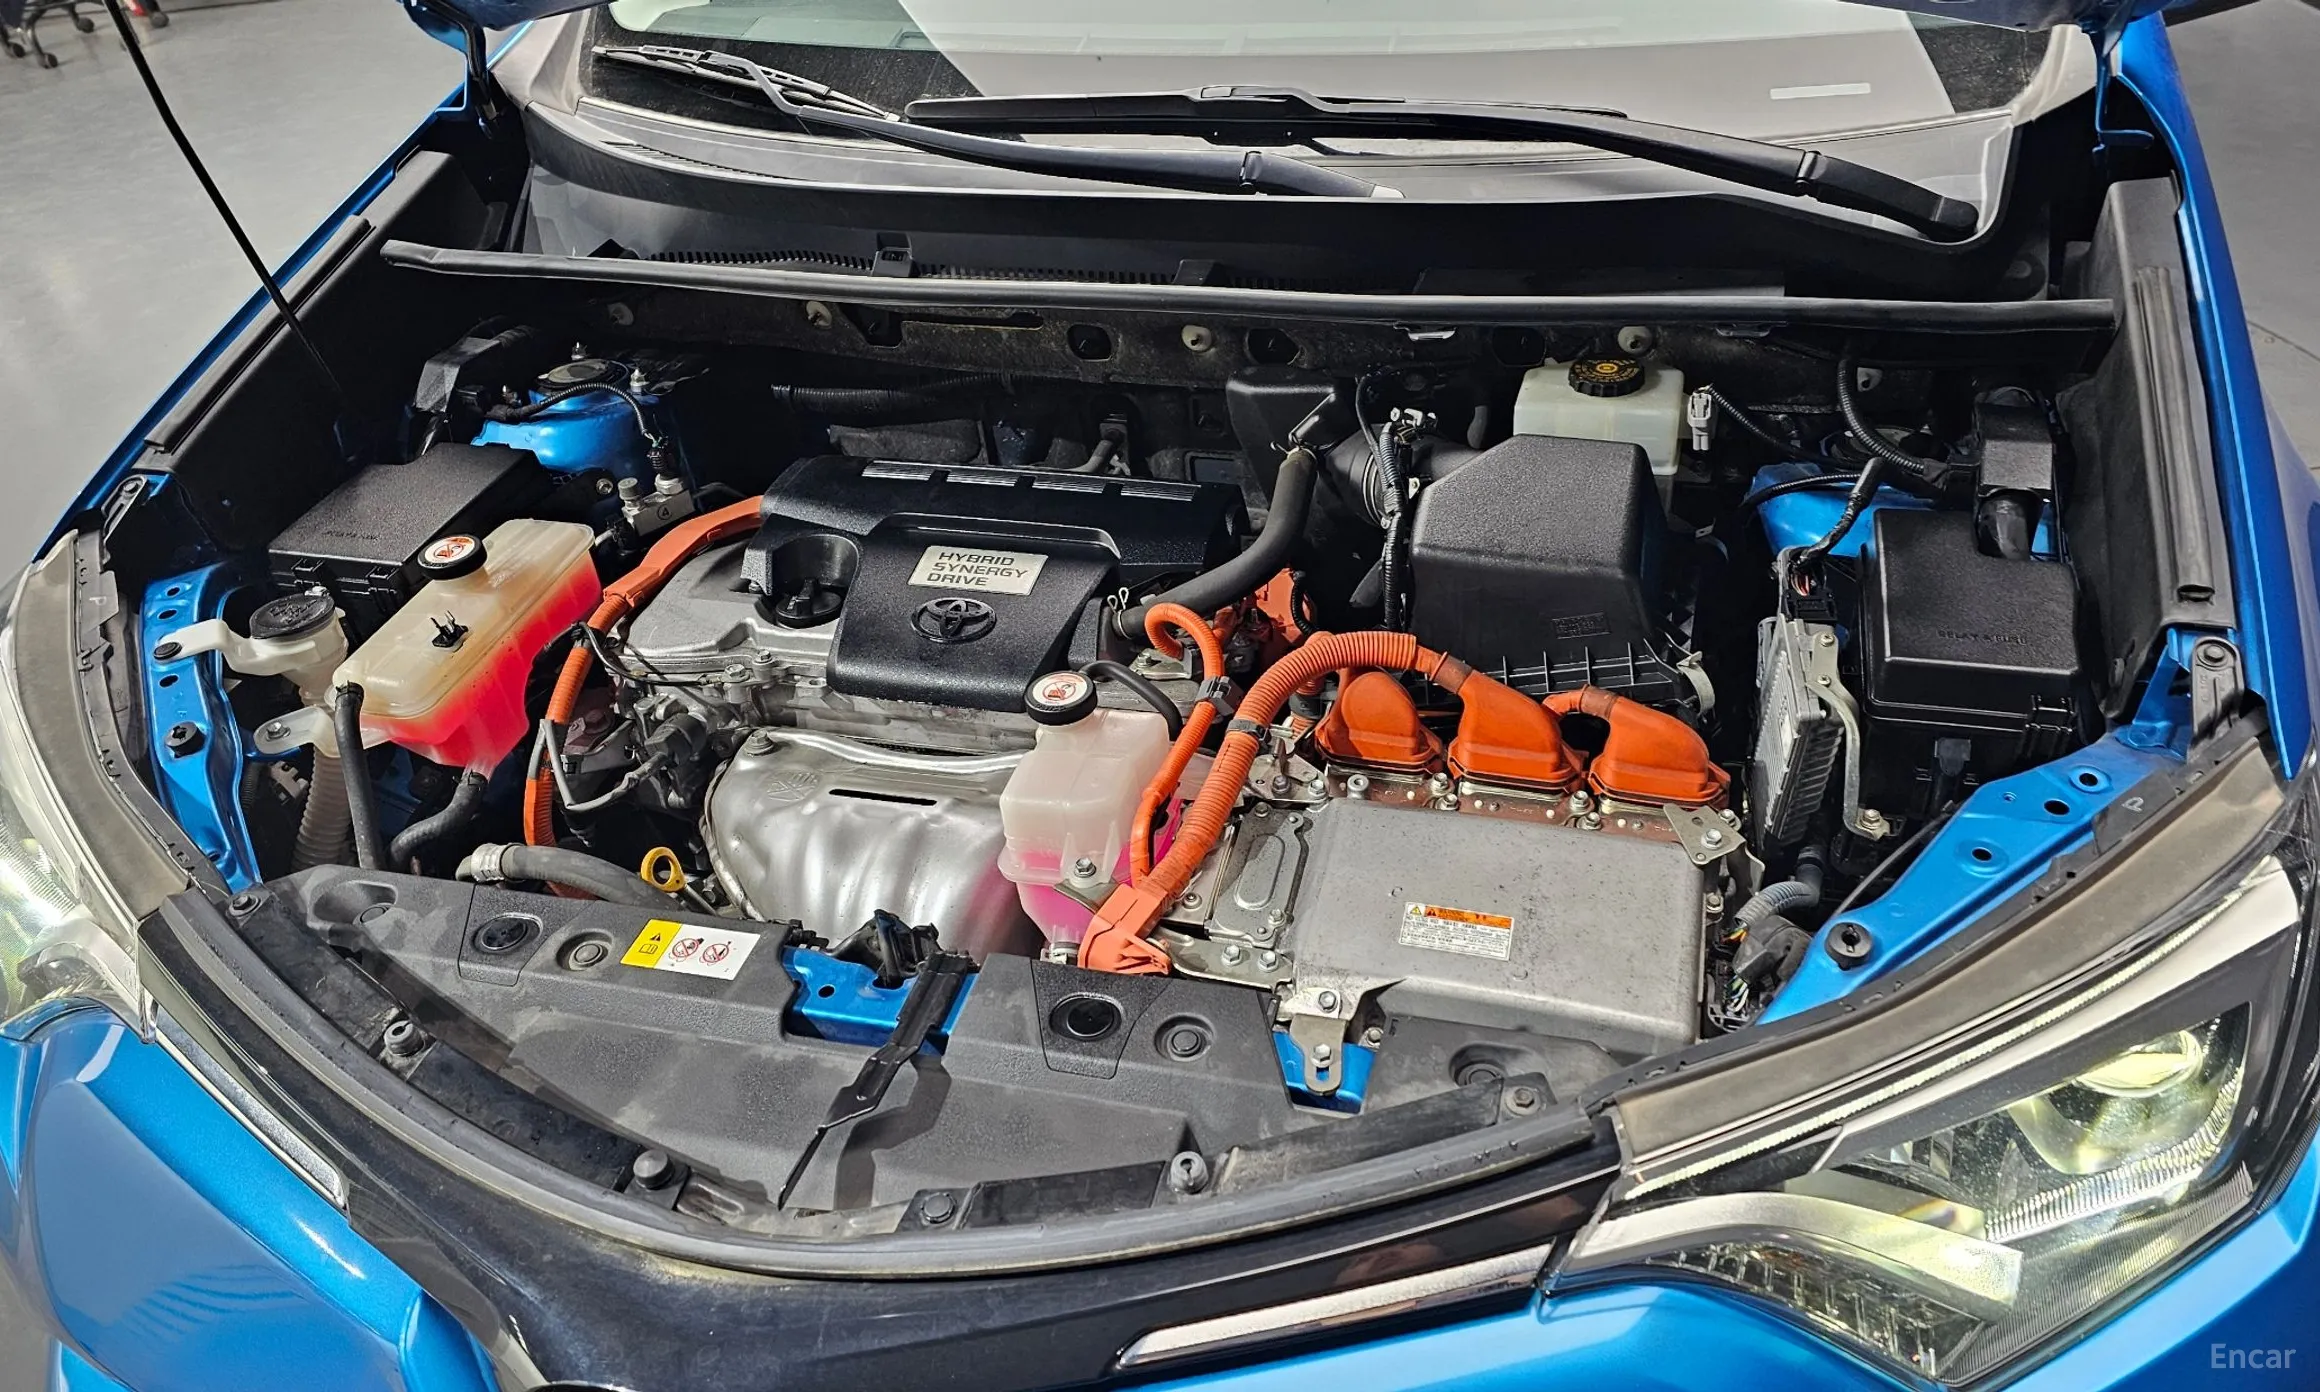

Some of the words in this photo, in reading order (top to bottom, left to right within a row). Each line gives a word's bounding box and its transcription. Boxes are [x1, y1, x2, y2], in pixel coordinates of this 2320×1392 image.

[938, 552, 1015, 566] HYBRID
[932, 562, 1028, 578] SYNERGY
[926, 572, 989, 586] DRIVE
